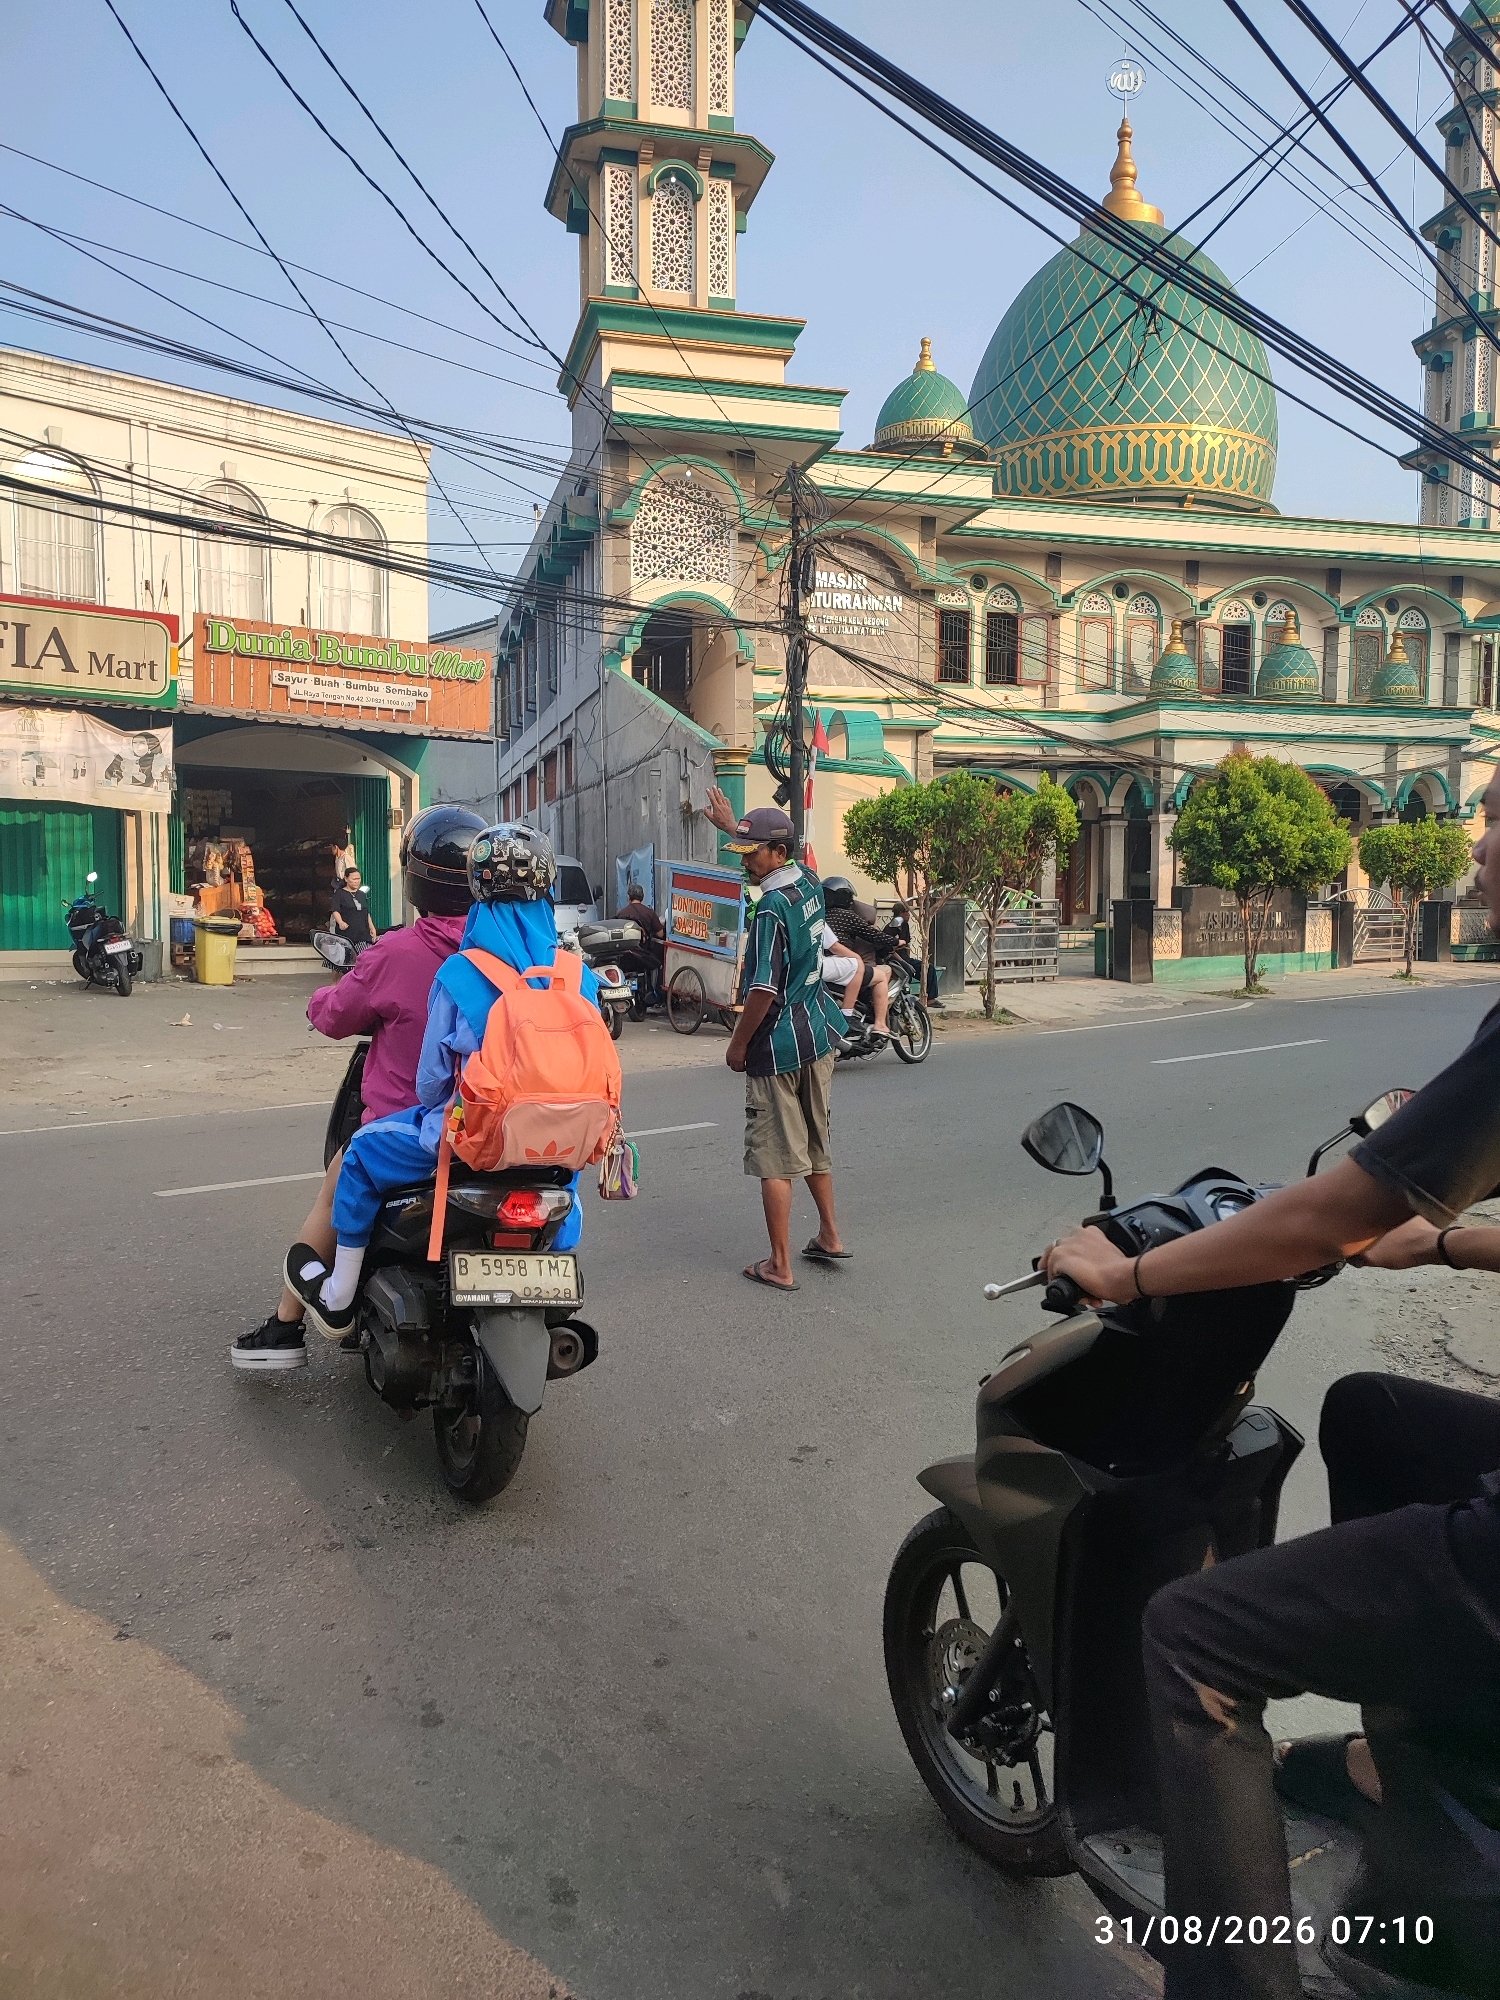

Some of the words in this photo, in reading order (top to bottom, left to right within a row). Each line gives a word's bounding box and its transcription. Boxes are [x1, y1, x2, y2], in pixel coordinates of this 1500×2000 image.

[815, 571, 867, 589] MASJID
[208, 620, 313, 661] Dunia
[317, 634, 428, 674] Bumbu
[431, 650, 486, 679] Mart
[87, 650, 158, 682] Mart
[672, 894, 712, 919] LONTONG
[676, 916, 708, 939] SAYUR
[385, 1197, 417, 1208] GEAR
[457, 1257, 469, 1276] B
[480, 1258, 528, 1277] 5958
[536, 1260, 572, 1278] TMZ
[463, 1293, 491, 1303] YAMAHA
